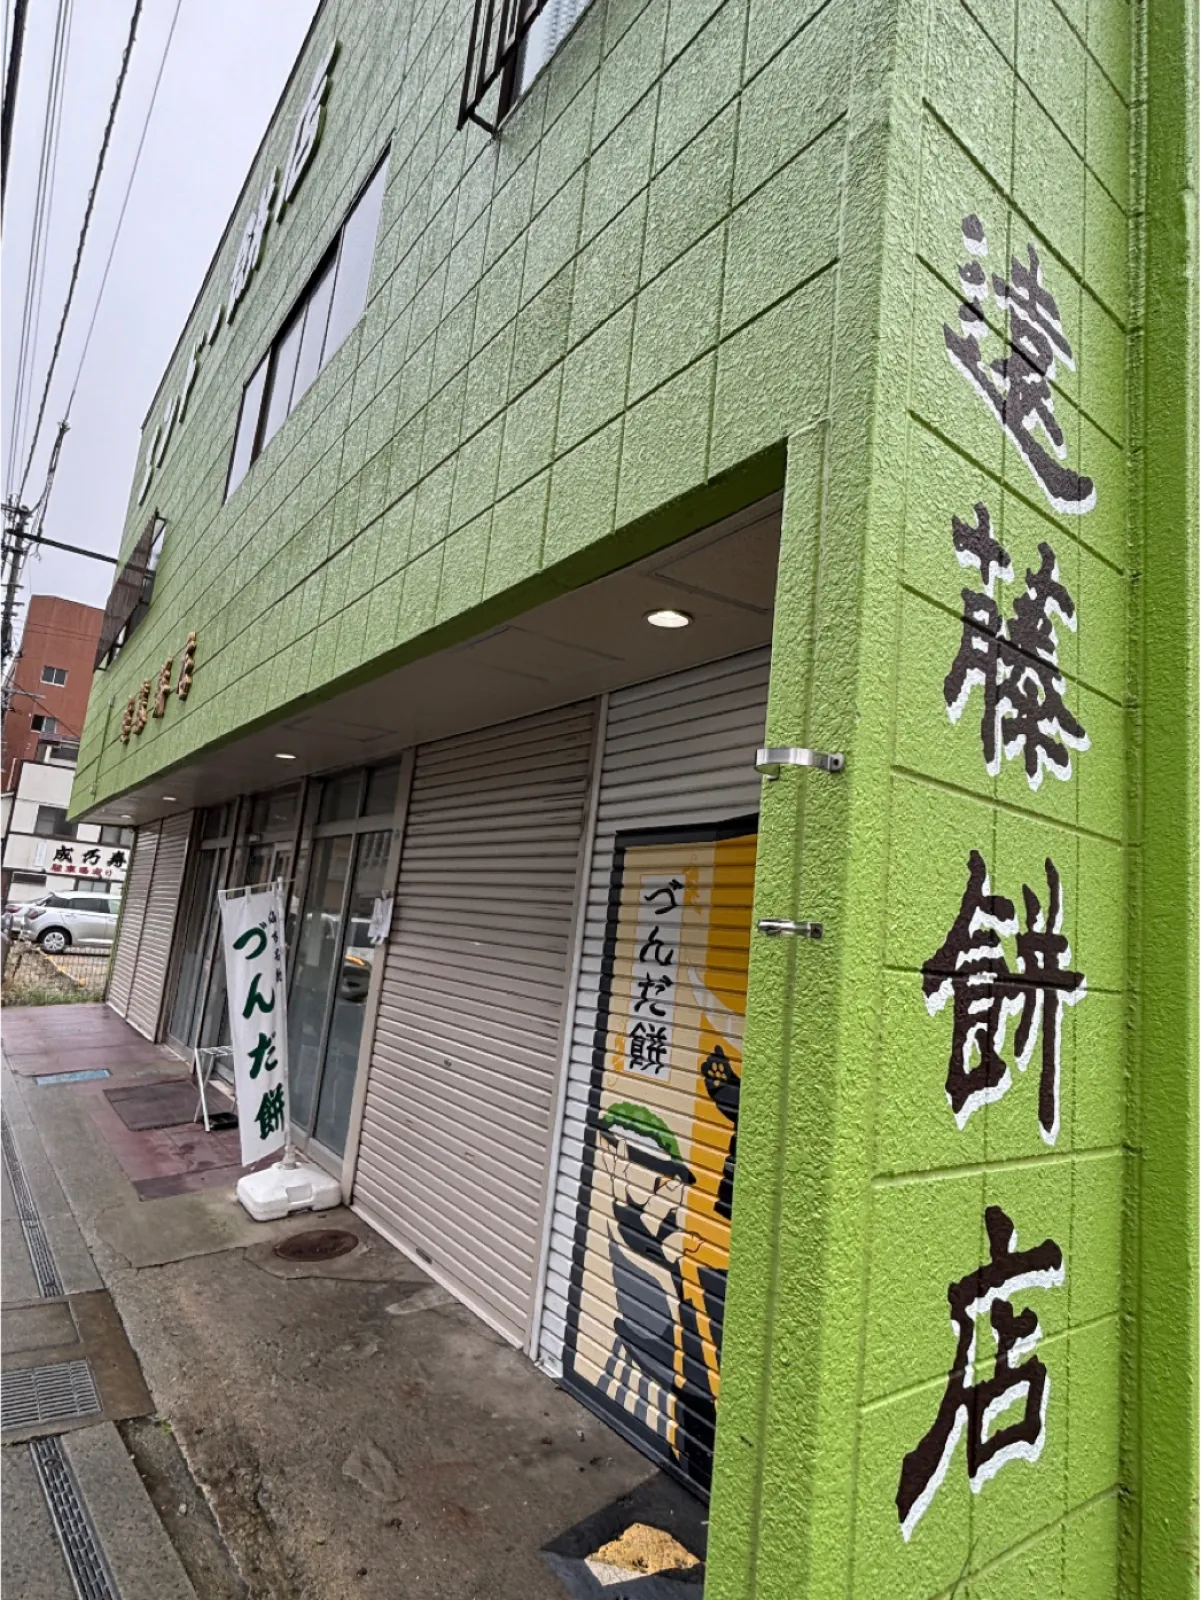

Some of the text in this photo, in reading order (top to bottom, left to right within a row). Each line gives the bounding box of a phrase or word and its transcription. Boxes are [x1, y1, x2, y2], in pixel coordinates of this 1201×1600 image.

[629, 878, 684, 1075] づんだ餅
[898, 213, 1096, 1541] 遠藤餅店
[233, 921, 285, 1140] づんだ餅
